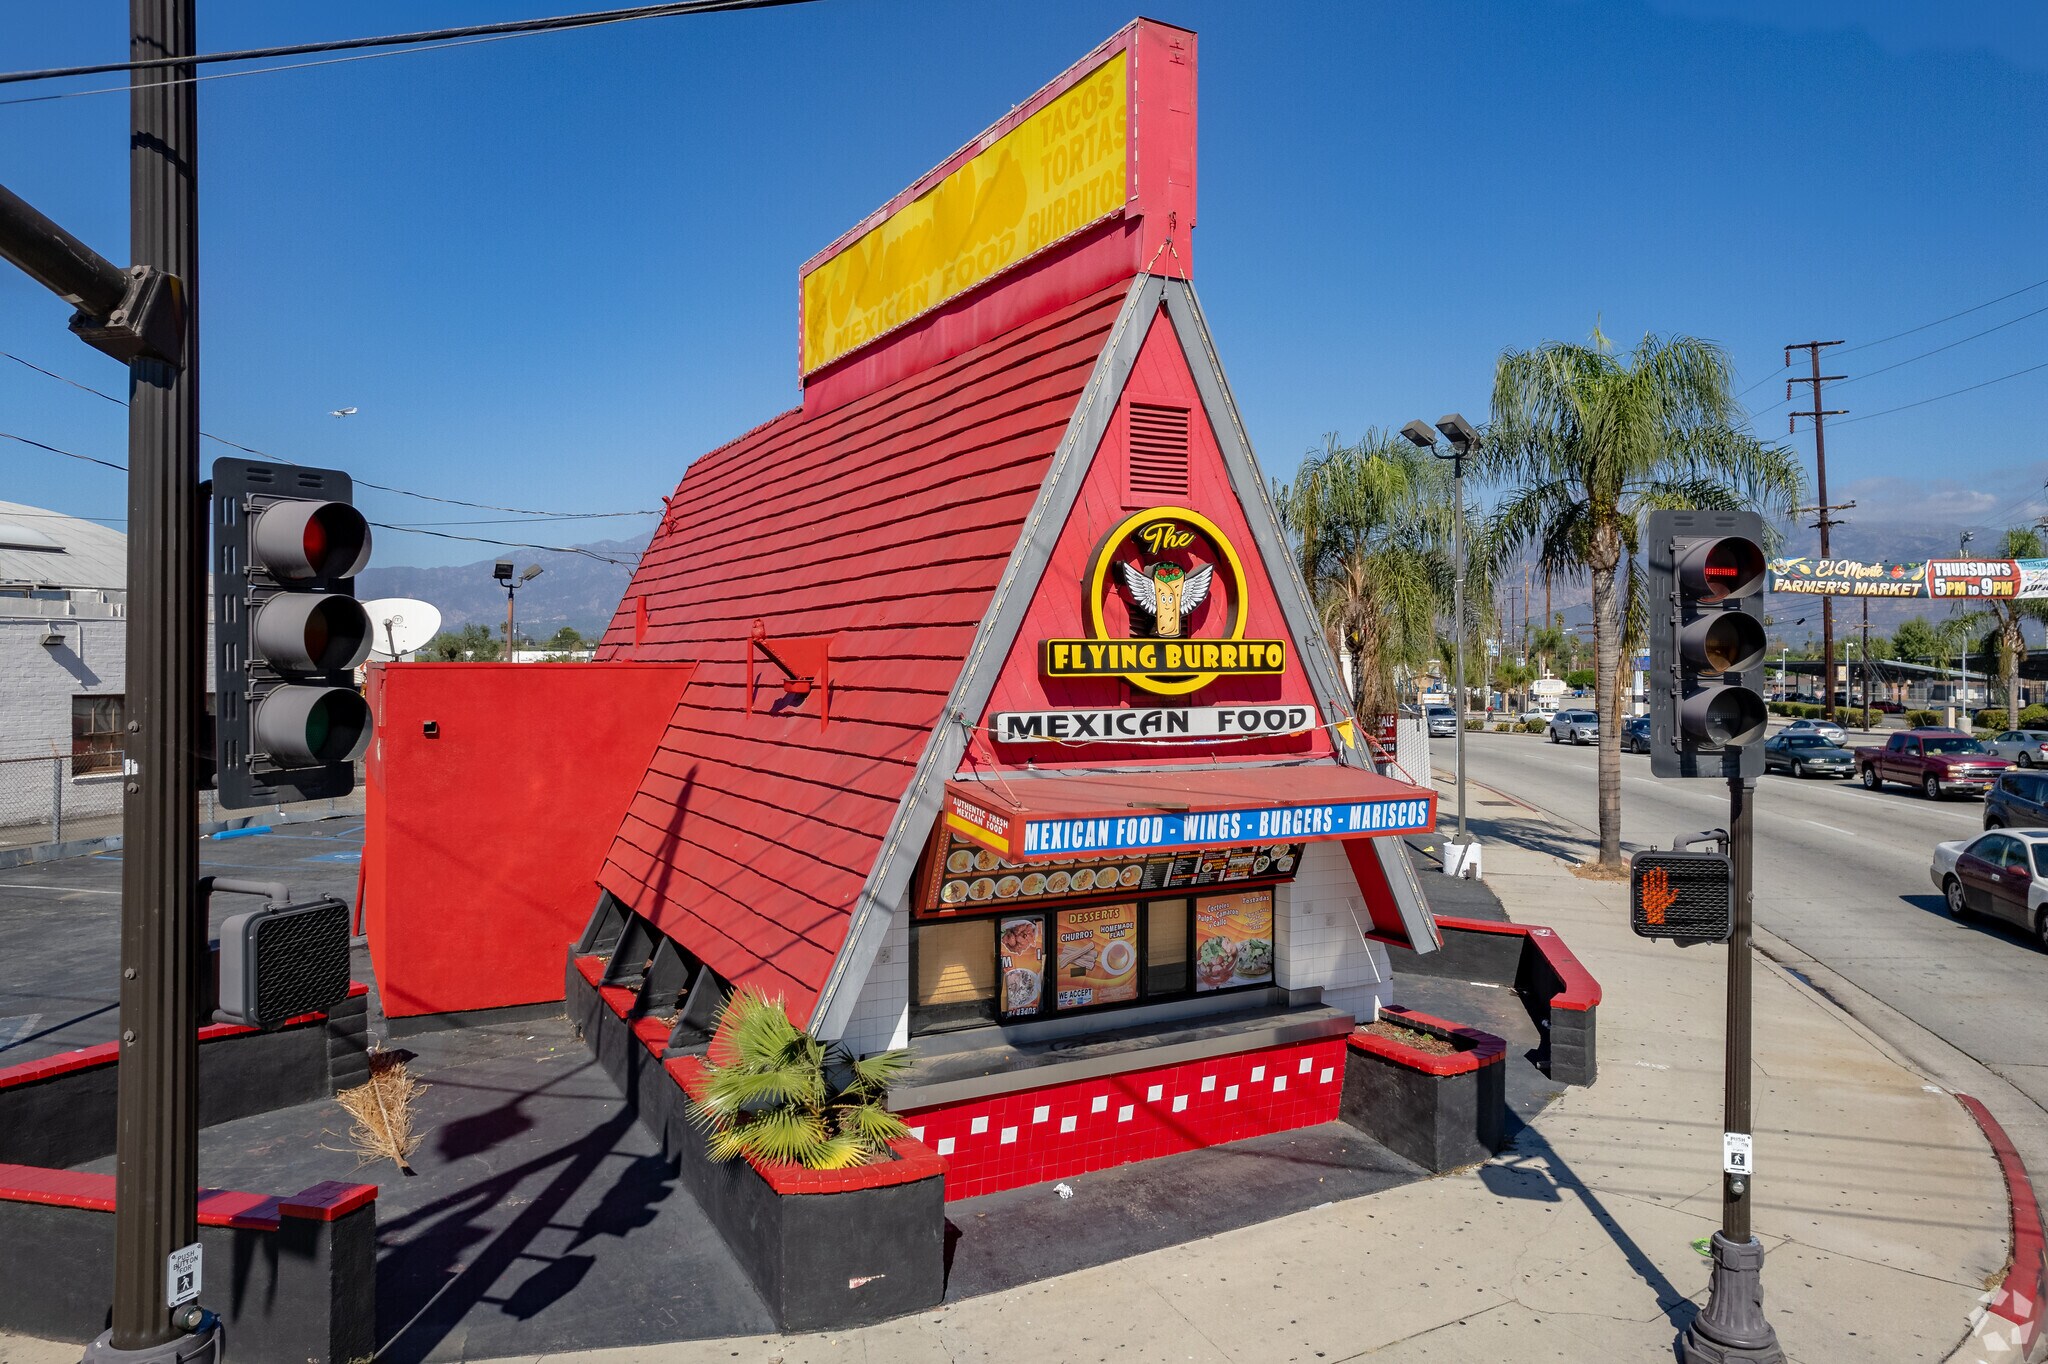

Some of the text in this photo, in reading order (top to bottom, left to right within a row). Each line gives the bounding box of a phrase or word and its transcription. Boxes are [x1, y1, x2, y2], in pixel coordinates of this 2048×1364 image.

[1040, 73, 1114, 148] TACOS
[1041, 104, 1126, 193] TORTAS
[1027, 161, 1126, 251] BURRITOS
[833, 230, 1016, 354] MEXICAN FOOD
[1143, 523, 1195, 555] The
[1815, 559, 1884, 579] El Monte
[1933, 563, 2012, 576] THURSDAYS
[1773, 579, 1922, 596] FARMER'S MARKET
[1935, 578, 1966, 596] 5PM
[1968, 585, 1979, 596] to
[1981, 578, 2013, 596] 9PM
[1054, 643, 1283, 669] FLYING BURRITO
[1007, 708, 1307, 740] MEXICAN FOOD
[953, 797, 1008, 829] AUTHENTIC FRESH
[957, 807, 1003, 835] MEXICAN FOOD
[1024, 819, 1110, 851] MEXICAN
[1116, 817, 1163, 845] FOOD
[1183, 813, 1241, 841] WINGS
[1259, 807, 1333, 836] BURGERS
[1349, 801, 1427, 830] MARISCOS
[1207, 903, 1230, 912] Cocteles
[1242, 896, 1270, 904] Tostadas
[1069, 908, 1120, 924] DESSERTS
[1061, 930, 1093, 942] CHURROS
[1100, 922, 1134, 933] HOMEMADE
[1109, 930, 1125, 939] FLAN
[1058, 992, 1068, 1000] WE
[1069, 989, 1092, 998] ACCEPT
[173, 1255, 198, 1270] BUTTON
[177, 1250, 194, 1262] PUSH
[179, 1264, 192, 1273] FOR
